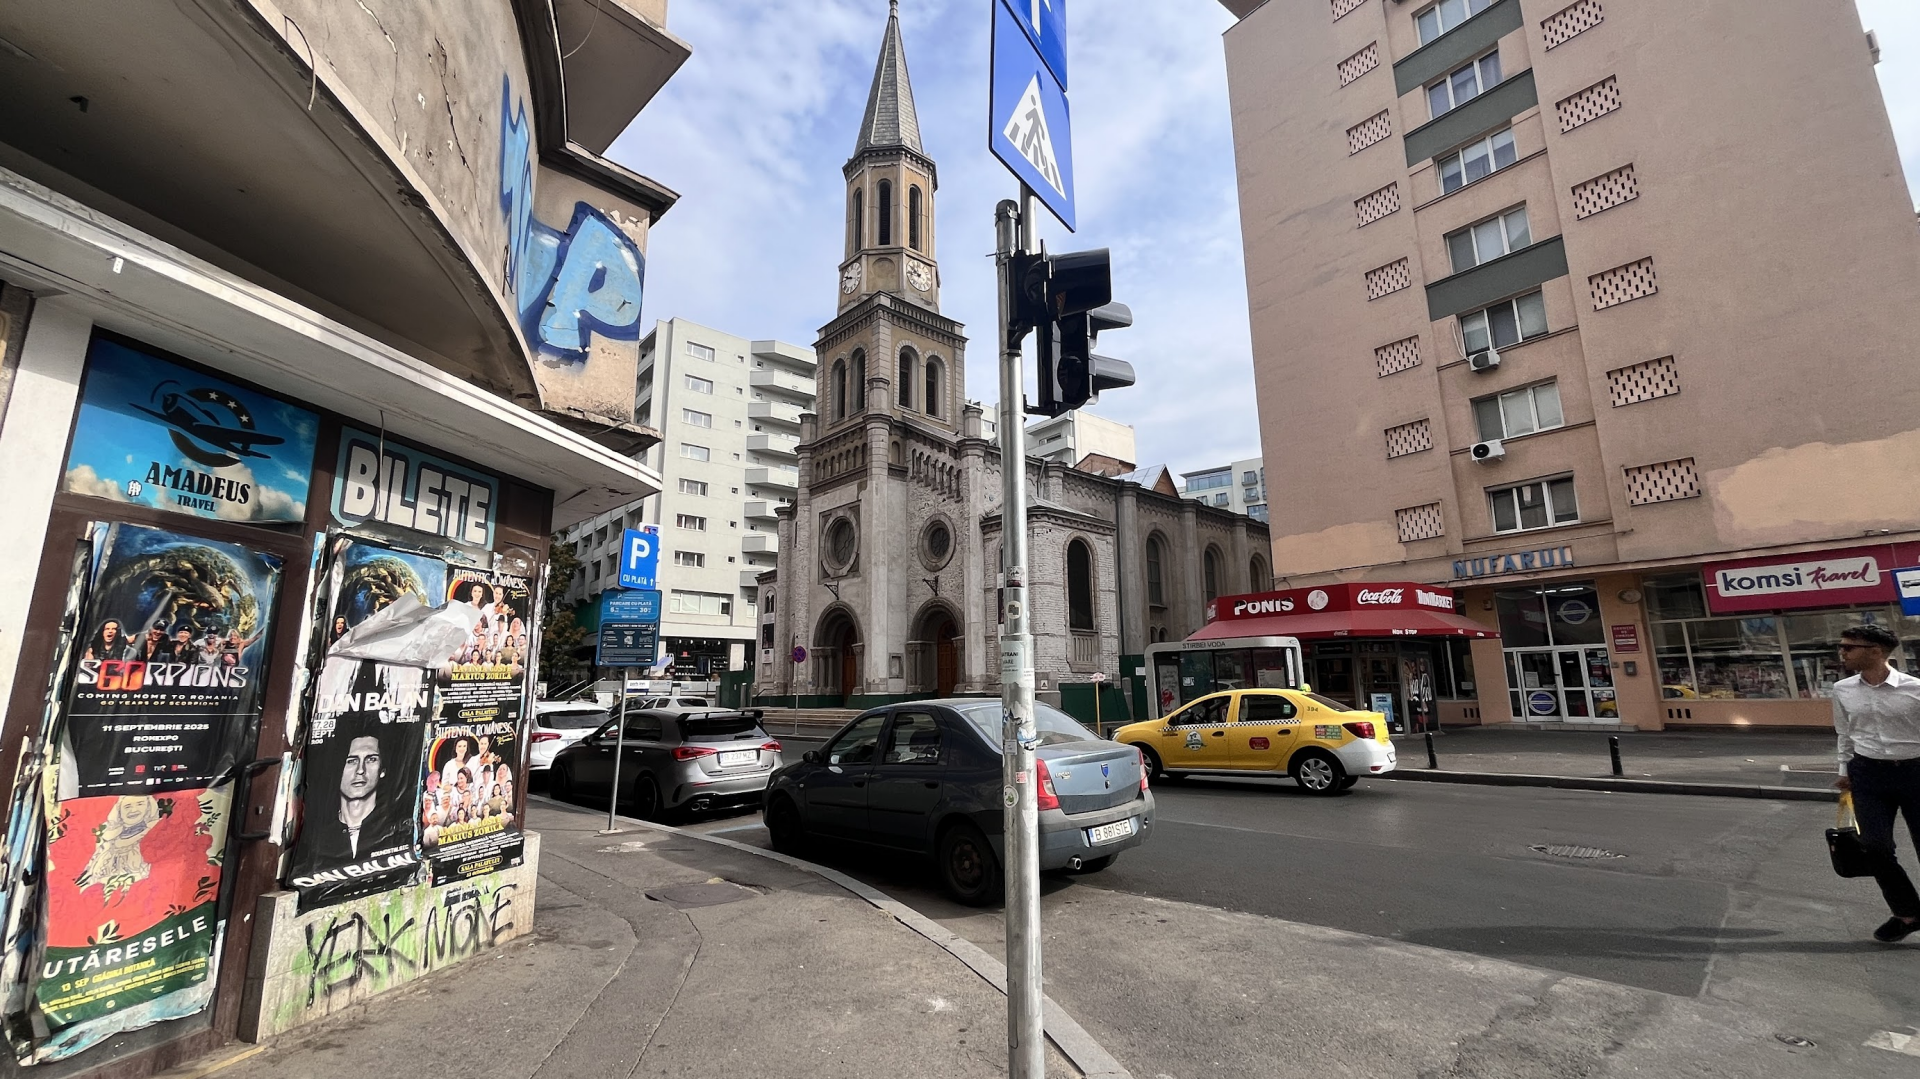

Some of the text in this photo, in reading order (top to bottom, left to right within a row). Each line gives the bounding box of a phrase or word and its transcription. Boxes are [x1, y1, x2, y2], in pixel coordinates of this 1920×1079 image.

[144, 461, 251, 505] AMADEUS
[176, 494, 216, 513] TRAVEL
[343, 445, 490, 545] BILETE
[630, 537, 650, 570] P
[622, 574, 647, 585] CU PLATĂ
[1722, 562, 1876, 592] komsi travel
[1357, 588, 1405, 605] Coca-Cola
[1234, 597, 1295, 616] PONIS
[451, 672, 485, 681] MARIUS
[77, 692, 128, 700] COMING
[318, 691, 362, 713] DAN
[364, 690, 429, 712] BALAN
[102, 723, 210, 732] 11 SEPTEMBRIE 2025
[133, 734, 179, 742] ROMEXPO
[124, 744, 183, 754] BUCUREȘTI
[437, 829, 473, 846] MARIUS
[1094, 828, 1102, 841] B
[292, 869, 349, 888] DAN
[343, 851, 418, 877] BALAN
[74, 977, 90, 989] SEP
